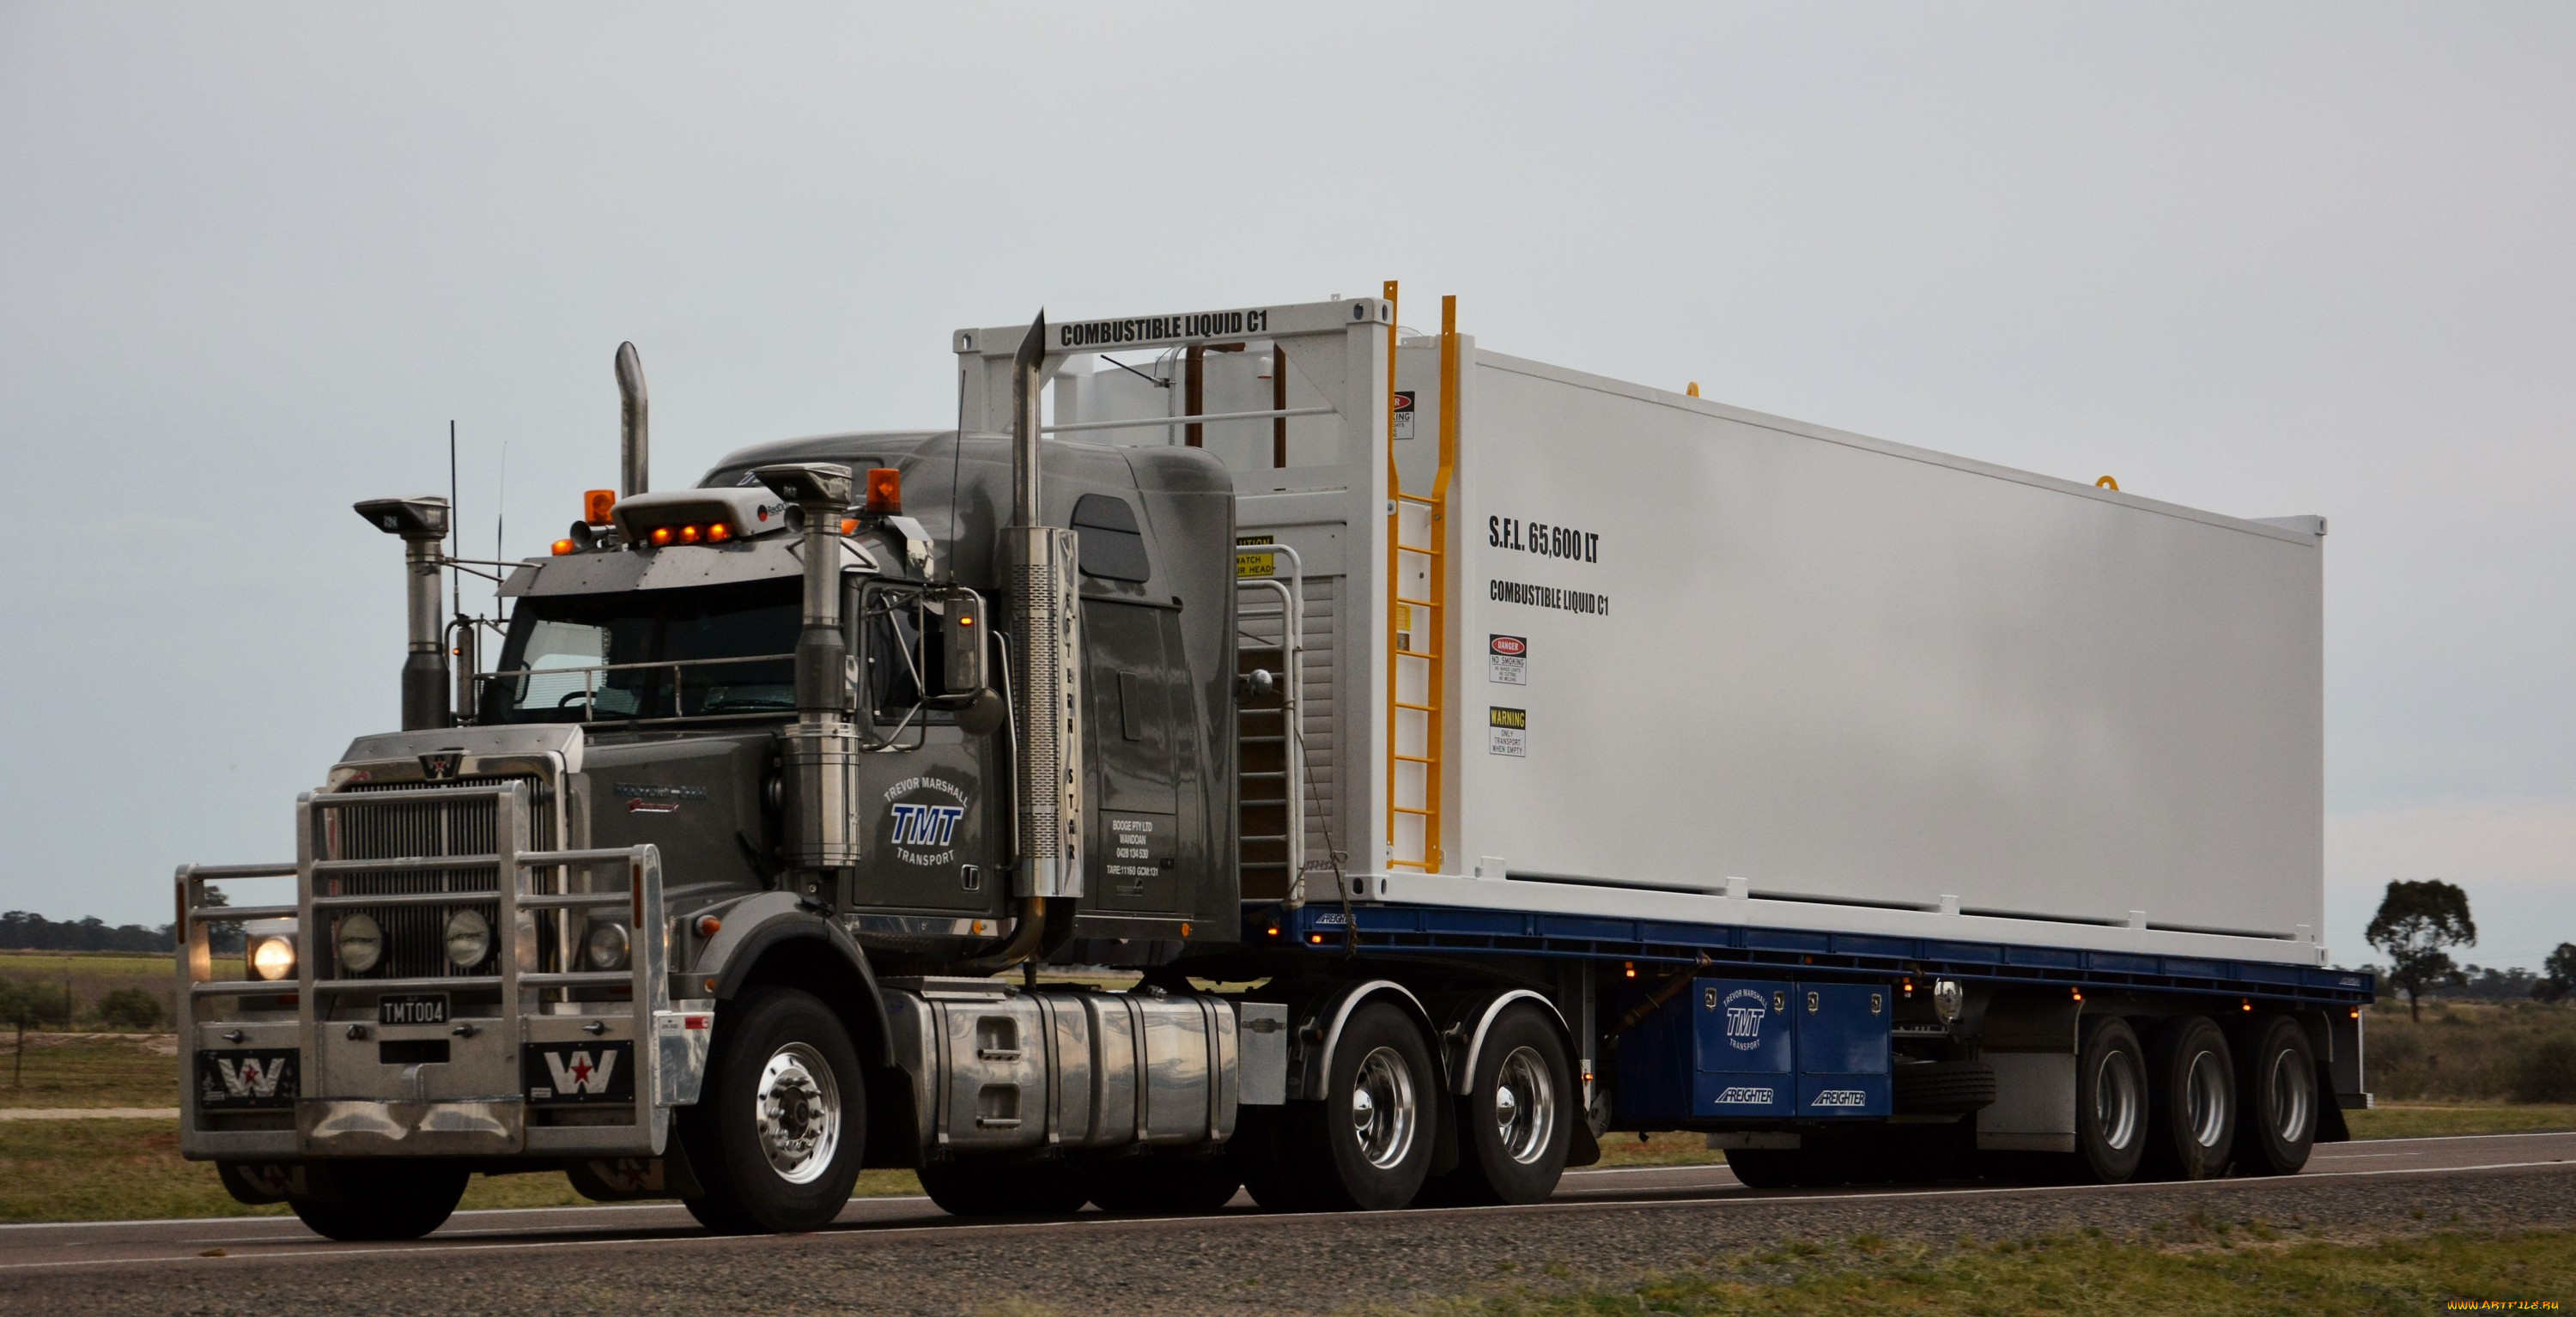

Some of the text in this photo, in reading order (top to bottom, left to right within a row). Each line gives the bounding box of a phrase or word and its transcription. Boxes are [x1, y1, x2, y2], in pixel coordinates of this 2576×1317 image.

[1060, 310, 1267, 346] COMBUSTIBLE LIQUID C1
[1489, 515, 1599, 563] S.F.L. 65,600 LT
[1249, 565, 1271, 574] HEAD
[1490, 579, 1608, 616] COMBUSTIBLE LIQUID C1
[1498, 640, 1519, 651] DANGER
[1502, 657, 1524, 666] SMOKING
[1491, 709, 1525, 727] WARNING
[1492, 744, 1505, 753] WHEN
[1494, 737, 1521, 746] TRANSPORT
[884, 777, 968, 808] TREVOR MARSHALL
[890, 803, 964, 847] TMT
[1132, 821, 1142, 831] PTY
[1142, 822, 1152, 832] LTD
[896, 847, 954, 866] TRANSPORT
[1723, 989, 1768, 1010] TREVOR MARSHALL
[384, 1002, 443, 1023] TMT004
[1727, 1007, 1765, 1037] TMT
[1729, 1037, 1760, 1051] TRANSPORT
[1715, 1087, 1773, 1104] FREIGHTER
[1811, 1090, 1866, 1107] FREIGHTER
